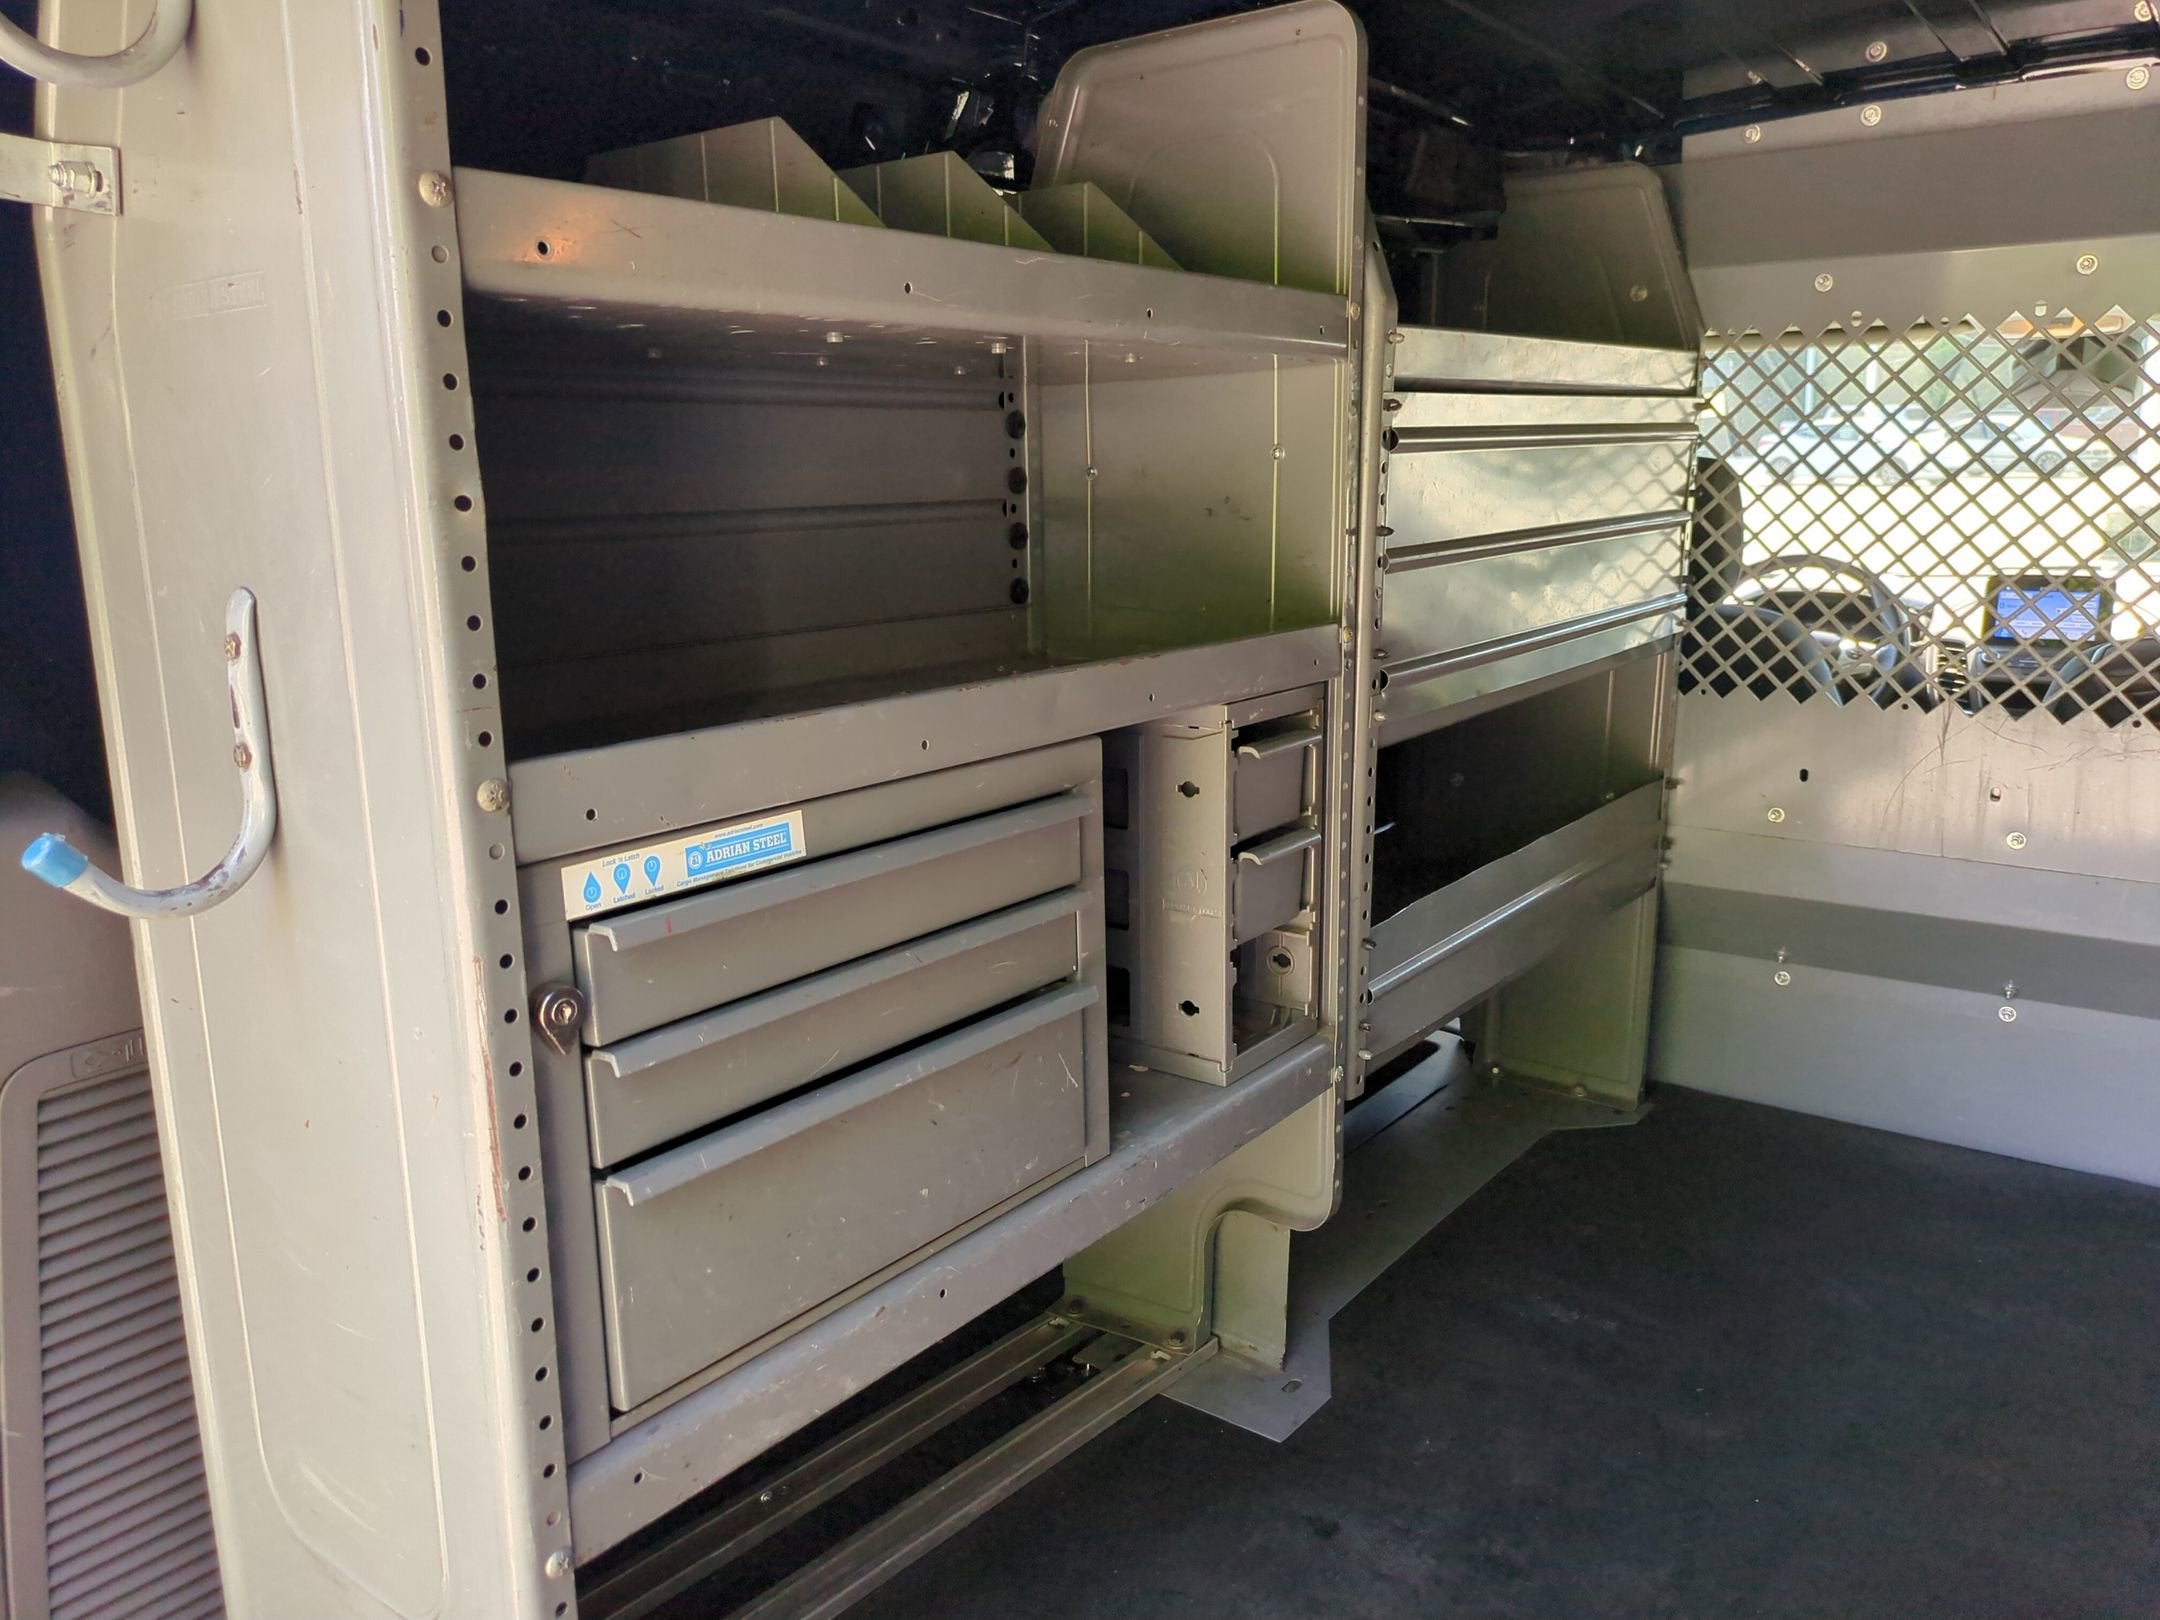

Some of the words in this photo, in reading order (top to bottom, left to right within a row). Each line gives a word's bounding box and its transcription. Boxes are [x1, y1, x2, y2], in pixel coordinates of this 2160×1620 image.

[706, 841, 750, 863] ADRIAN
[753, 833, 786, 850] STEEL
[602, 858, 616, 867] Lock
[624, 853, 640, 862] Latch
[677, 879, 692, 888] Cargo
[645, 885, 664, 895] Locked
[613, 892, 636, 903] Latched
[586, 902, 602, 911] Open
